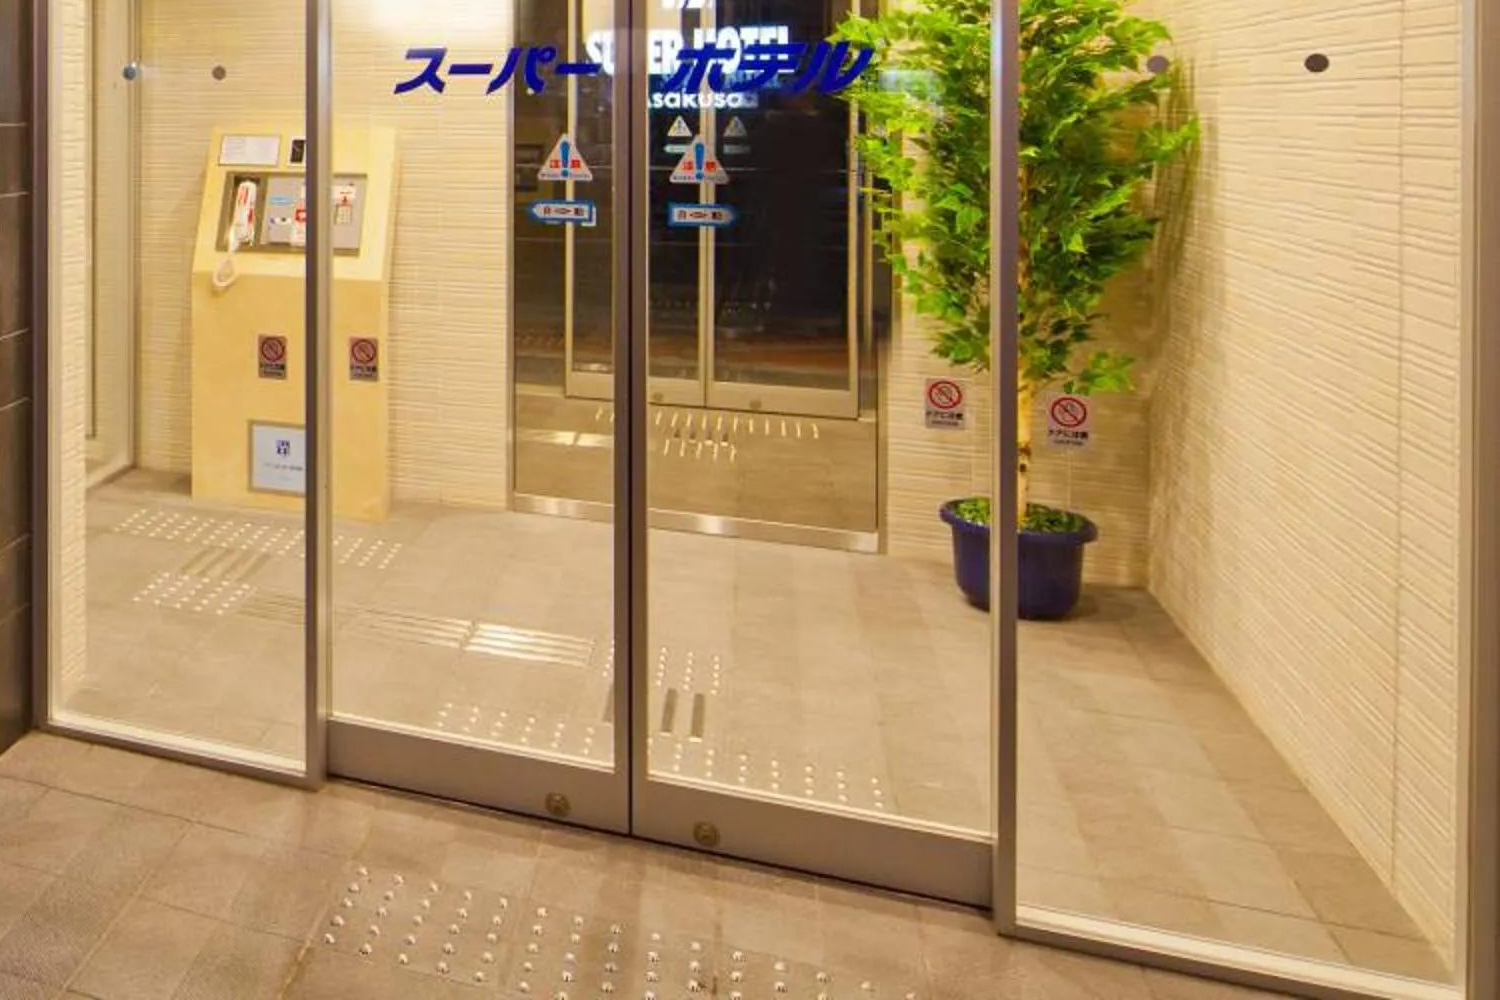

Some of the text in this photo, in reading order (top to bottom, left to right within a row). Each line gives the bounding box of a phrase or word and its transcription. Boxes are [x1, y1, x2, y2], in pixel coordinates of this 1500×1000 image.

[393, 41, 875, 96] スーパー ホテル
[647, 90, 743, 109] sakusa
